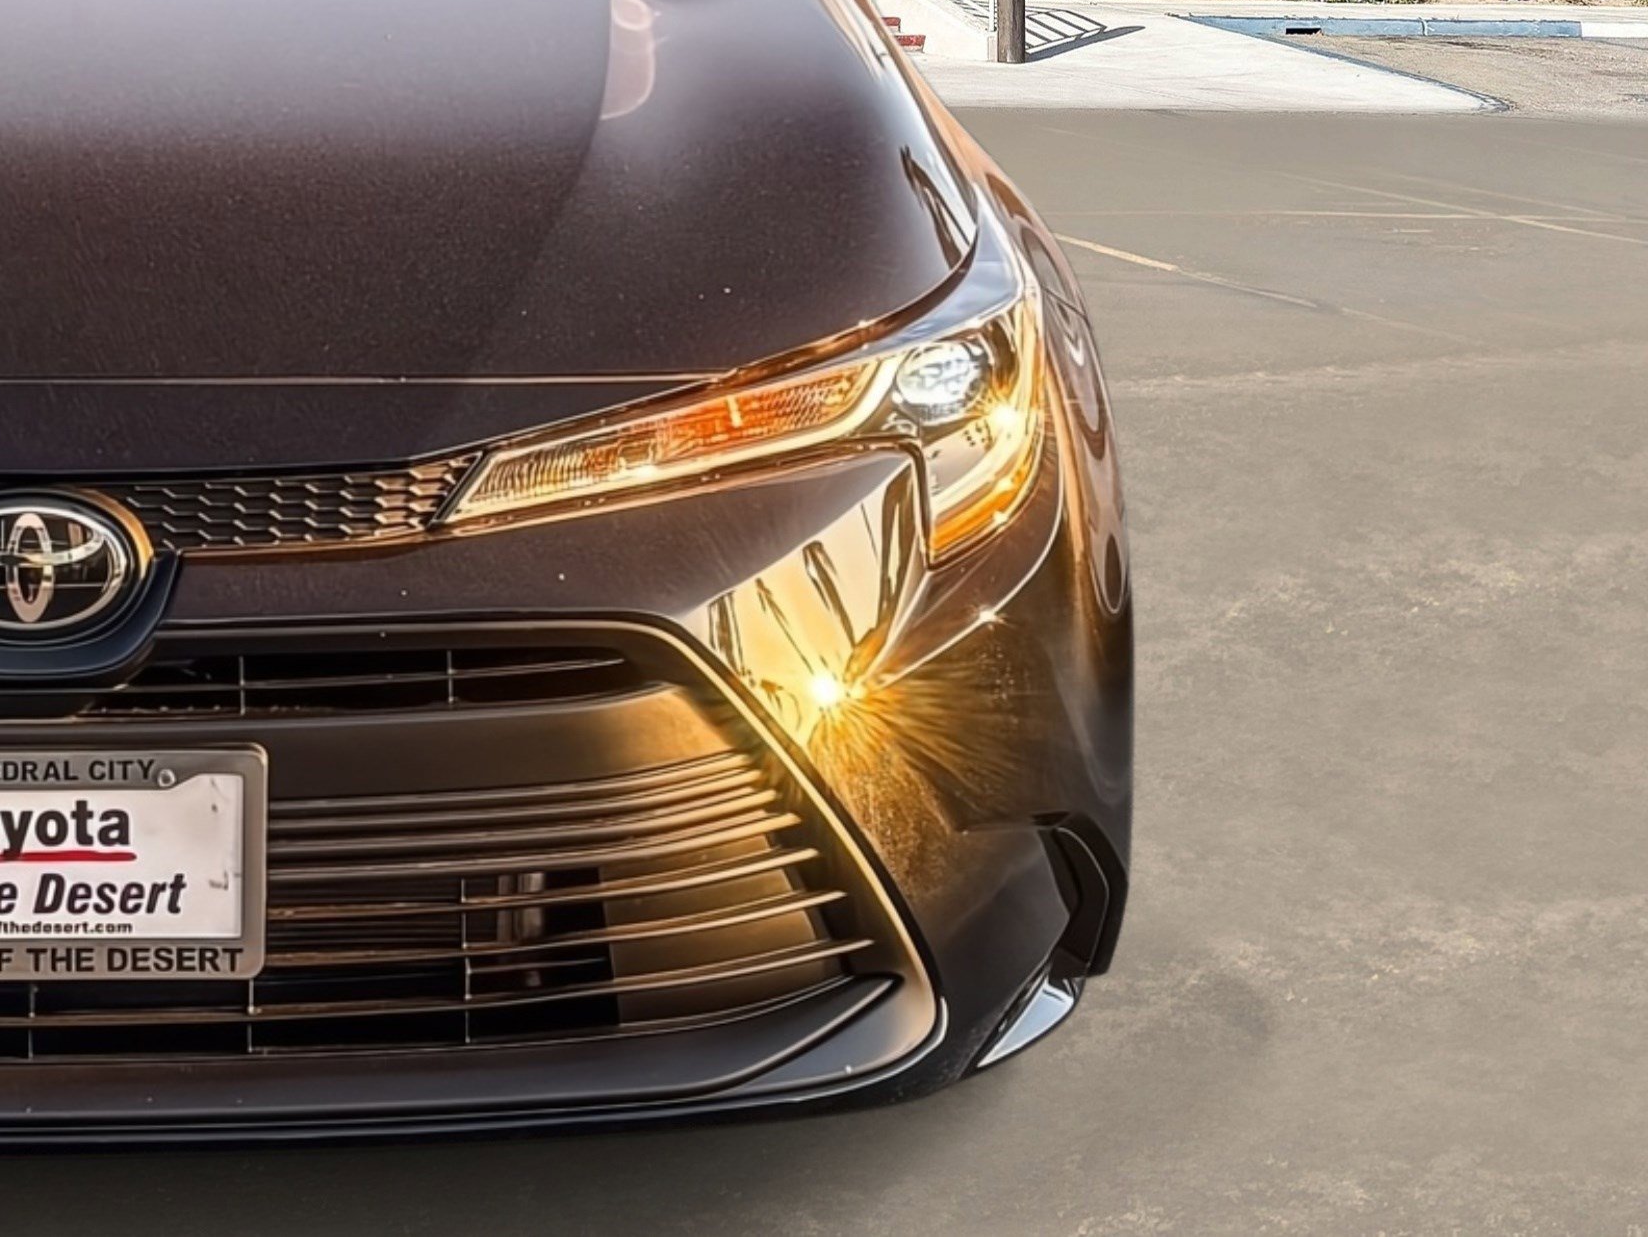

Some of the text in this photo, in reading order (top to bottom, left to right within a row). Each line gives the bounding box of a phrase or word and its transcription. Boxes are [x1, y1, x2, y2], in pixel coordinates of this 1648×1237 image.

[89, 759, 156, 781] CITY
[33, 873, 187, 915] Desert
[26, 948, 95, 973] THE
[106, 947, 244, 973] DESERT
